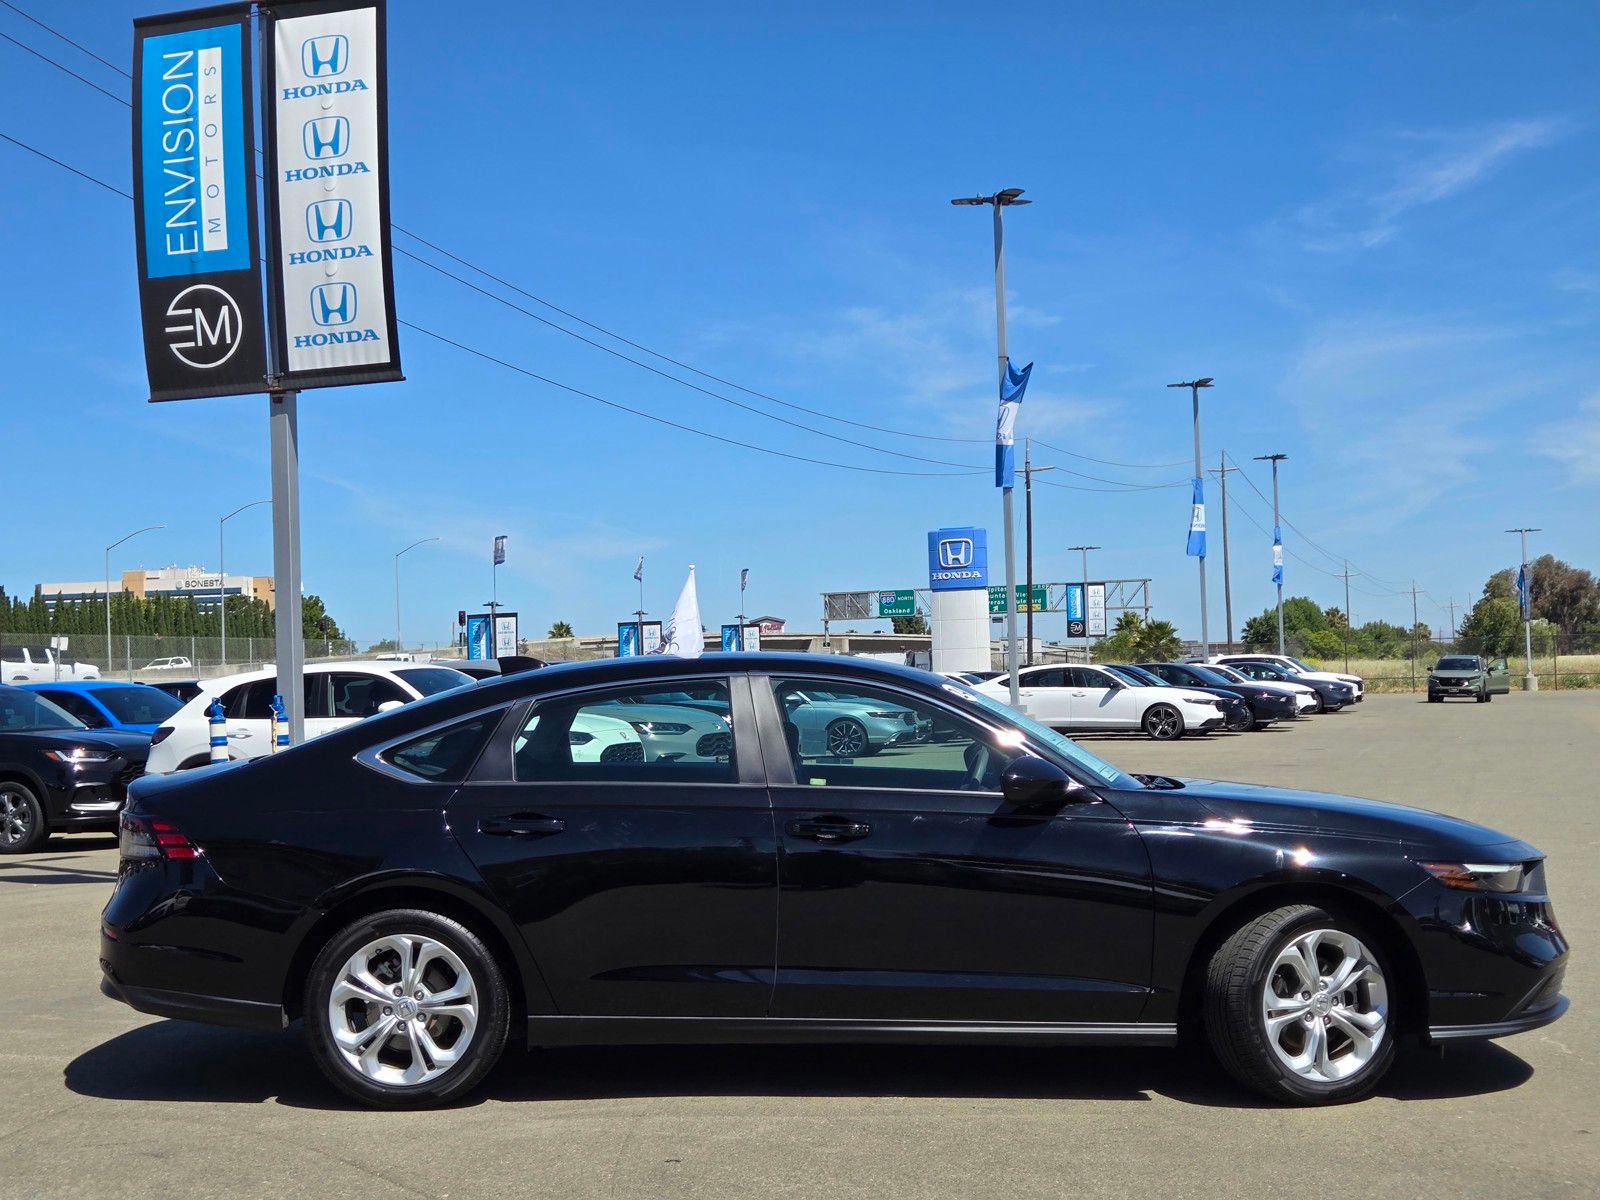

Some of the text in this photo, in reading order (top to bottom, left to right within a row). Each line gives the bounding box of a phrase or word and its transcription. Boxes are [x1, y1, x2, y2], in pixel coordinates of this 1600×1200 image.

[282, 79, 369, 101] HONDA
[162, 49, 198, 256] ENVISION
[204, 65, 222, 234] MOTORS
[285, 160, 371, 182] HONDA
[288, 244, 374, 265] HONDA
[294, 328, 380, 349] HONDA
[184, 579, 224, 588] SONESTA
[932, 571, 982, 580] HONDA
